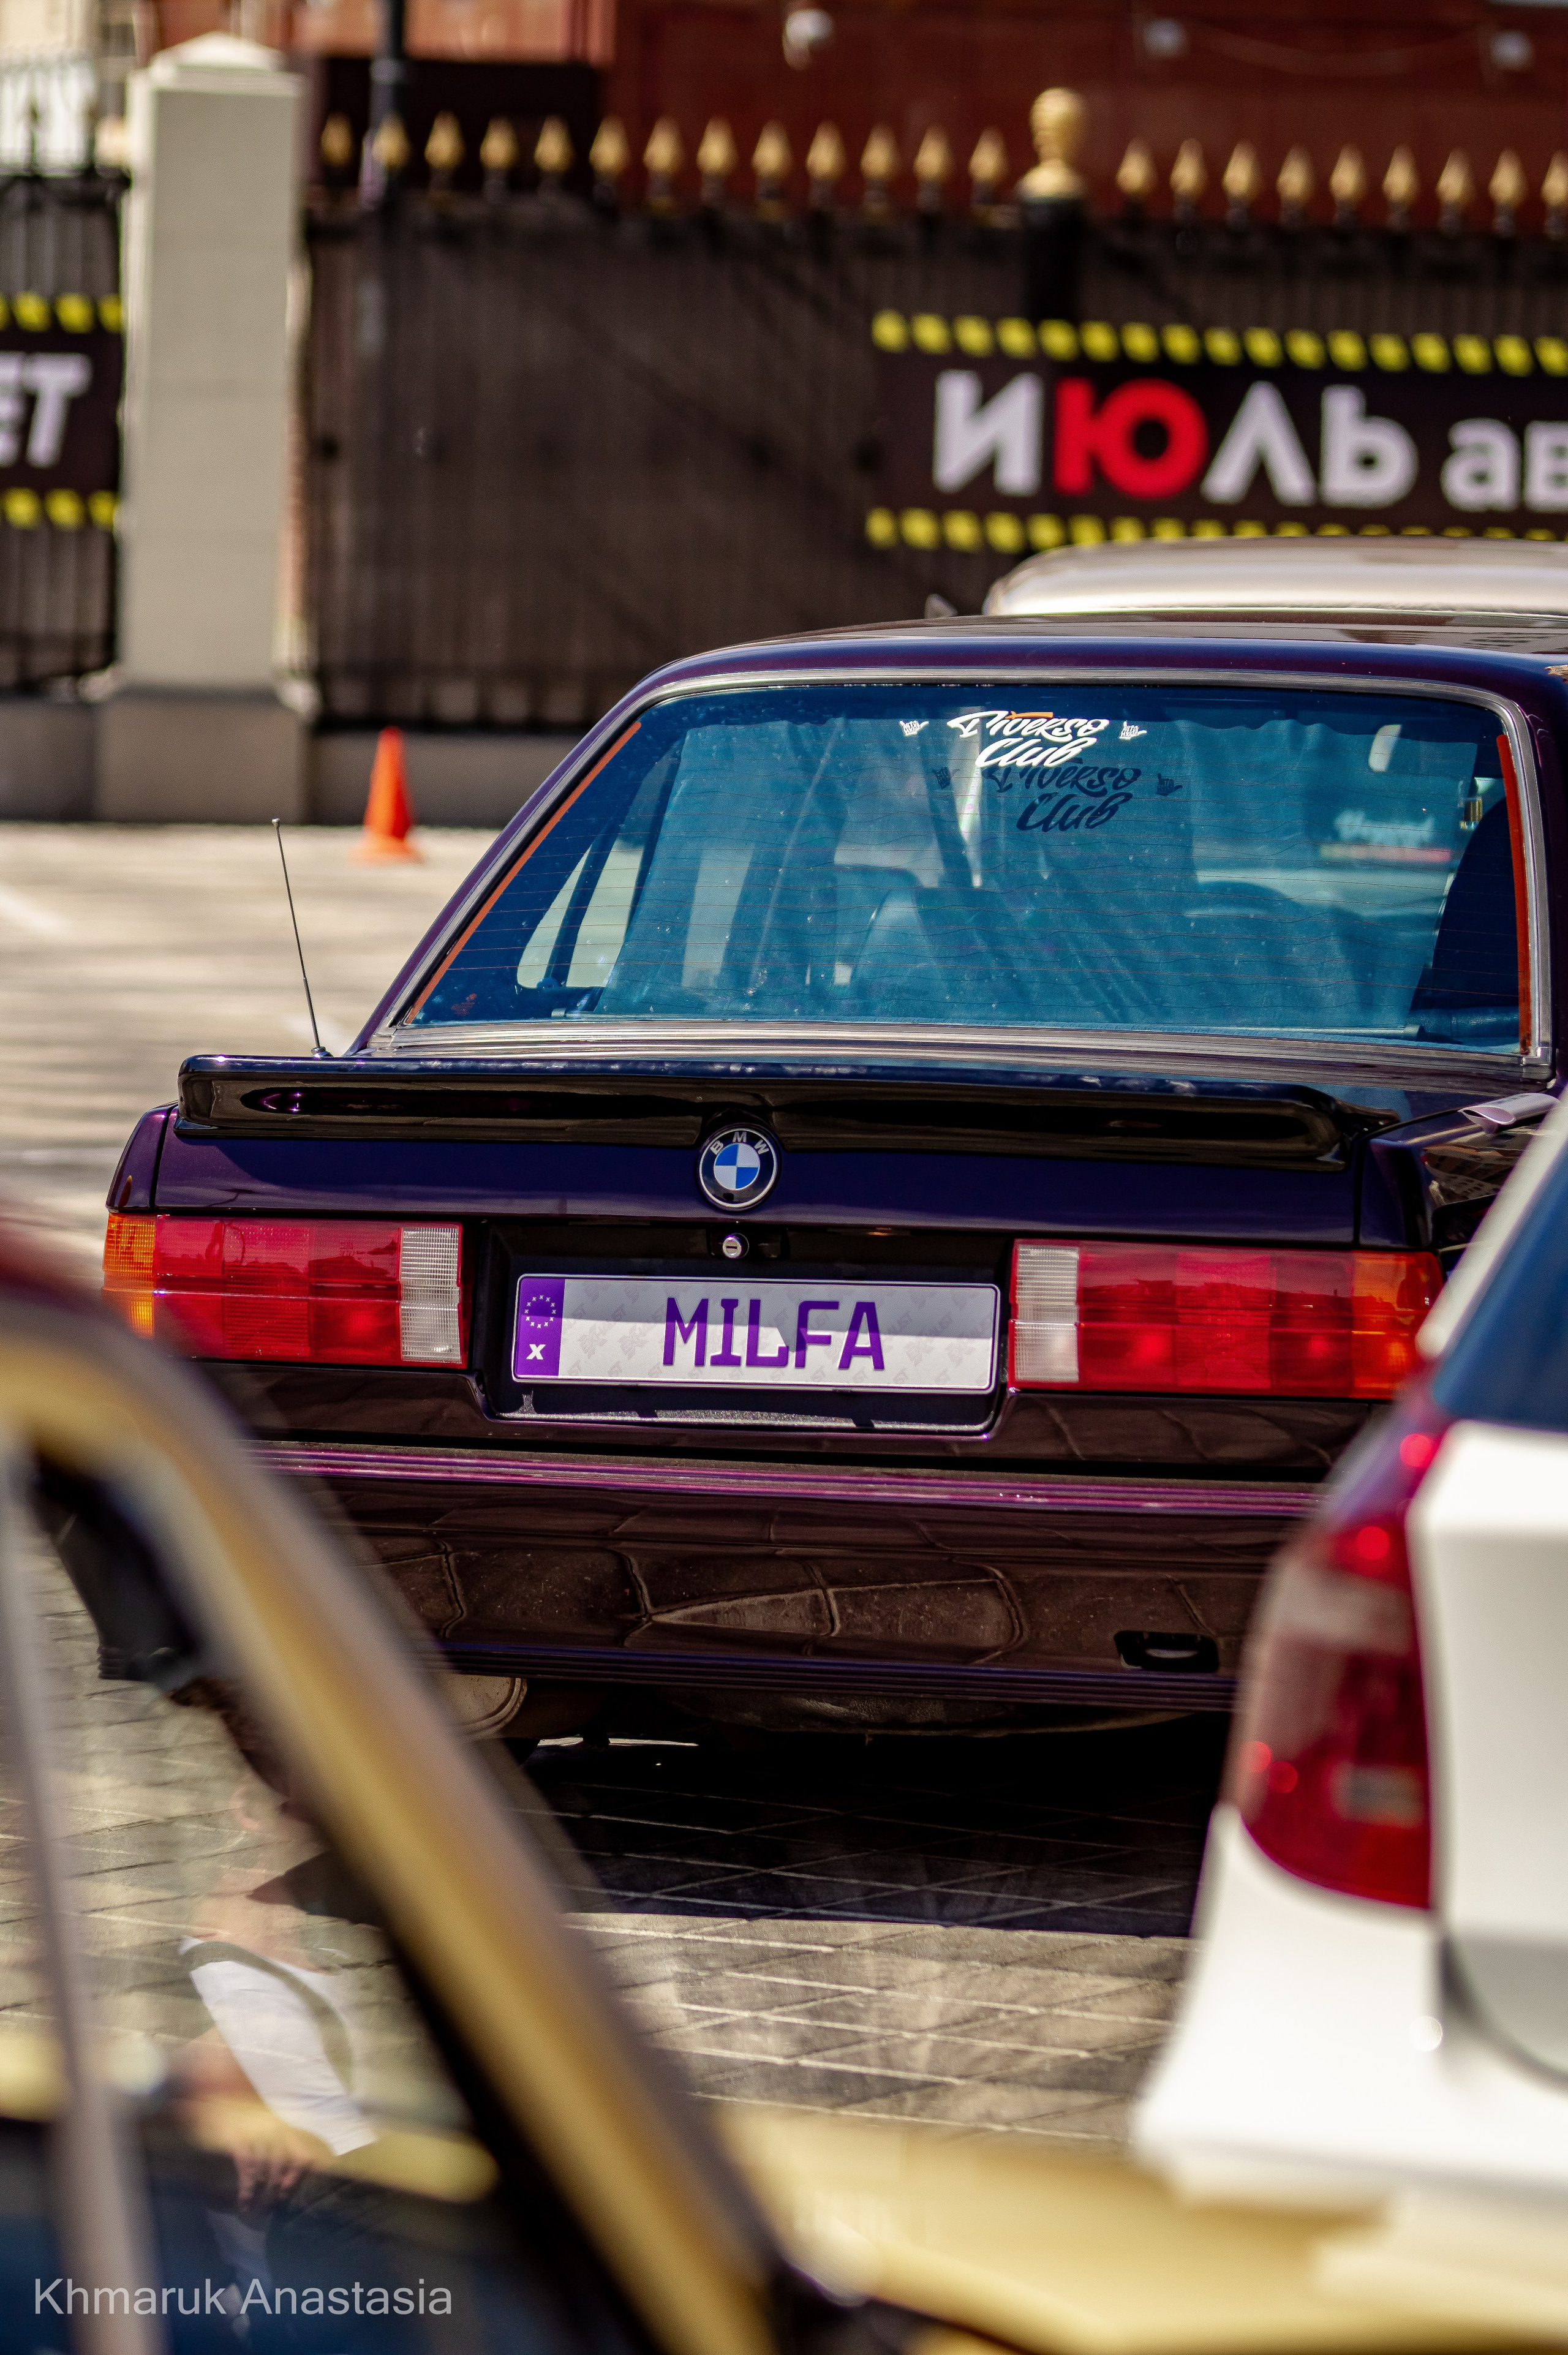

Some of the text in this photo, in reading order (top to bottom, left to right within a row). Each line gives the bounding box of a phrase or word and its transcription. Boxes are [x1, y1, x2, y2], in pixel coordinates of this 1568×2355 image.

[933, 370, 1419, 510] ИЮЛЬ
[709, 1131, 770, 1156] BMW
[663, 1297, 885, 1371] MILFA
